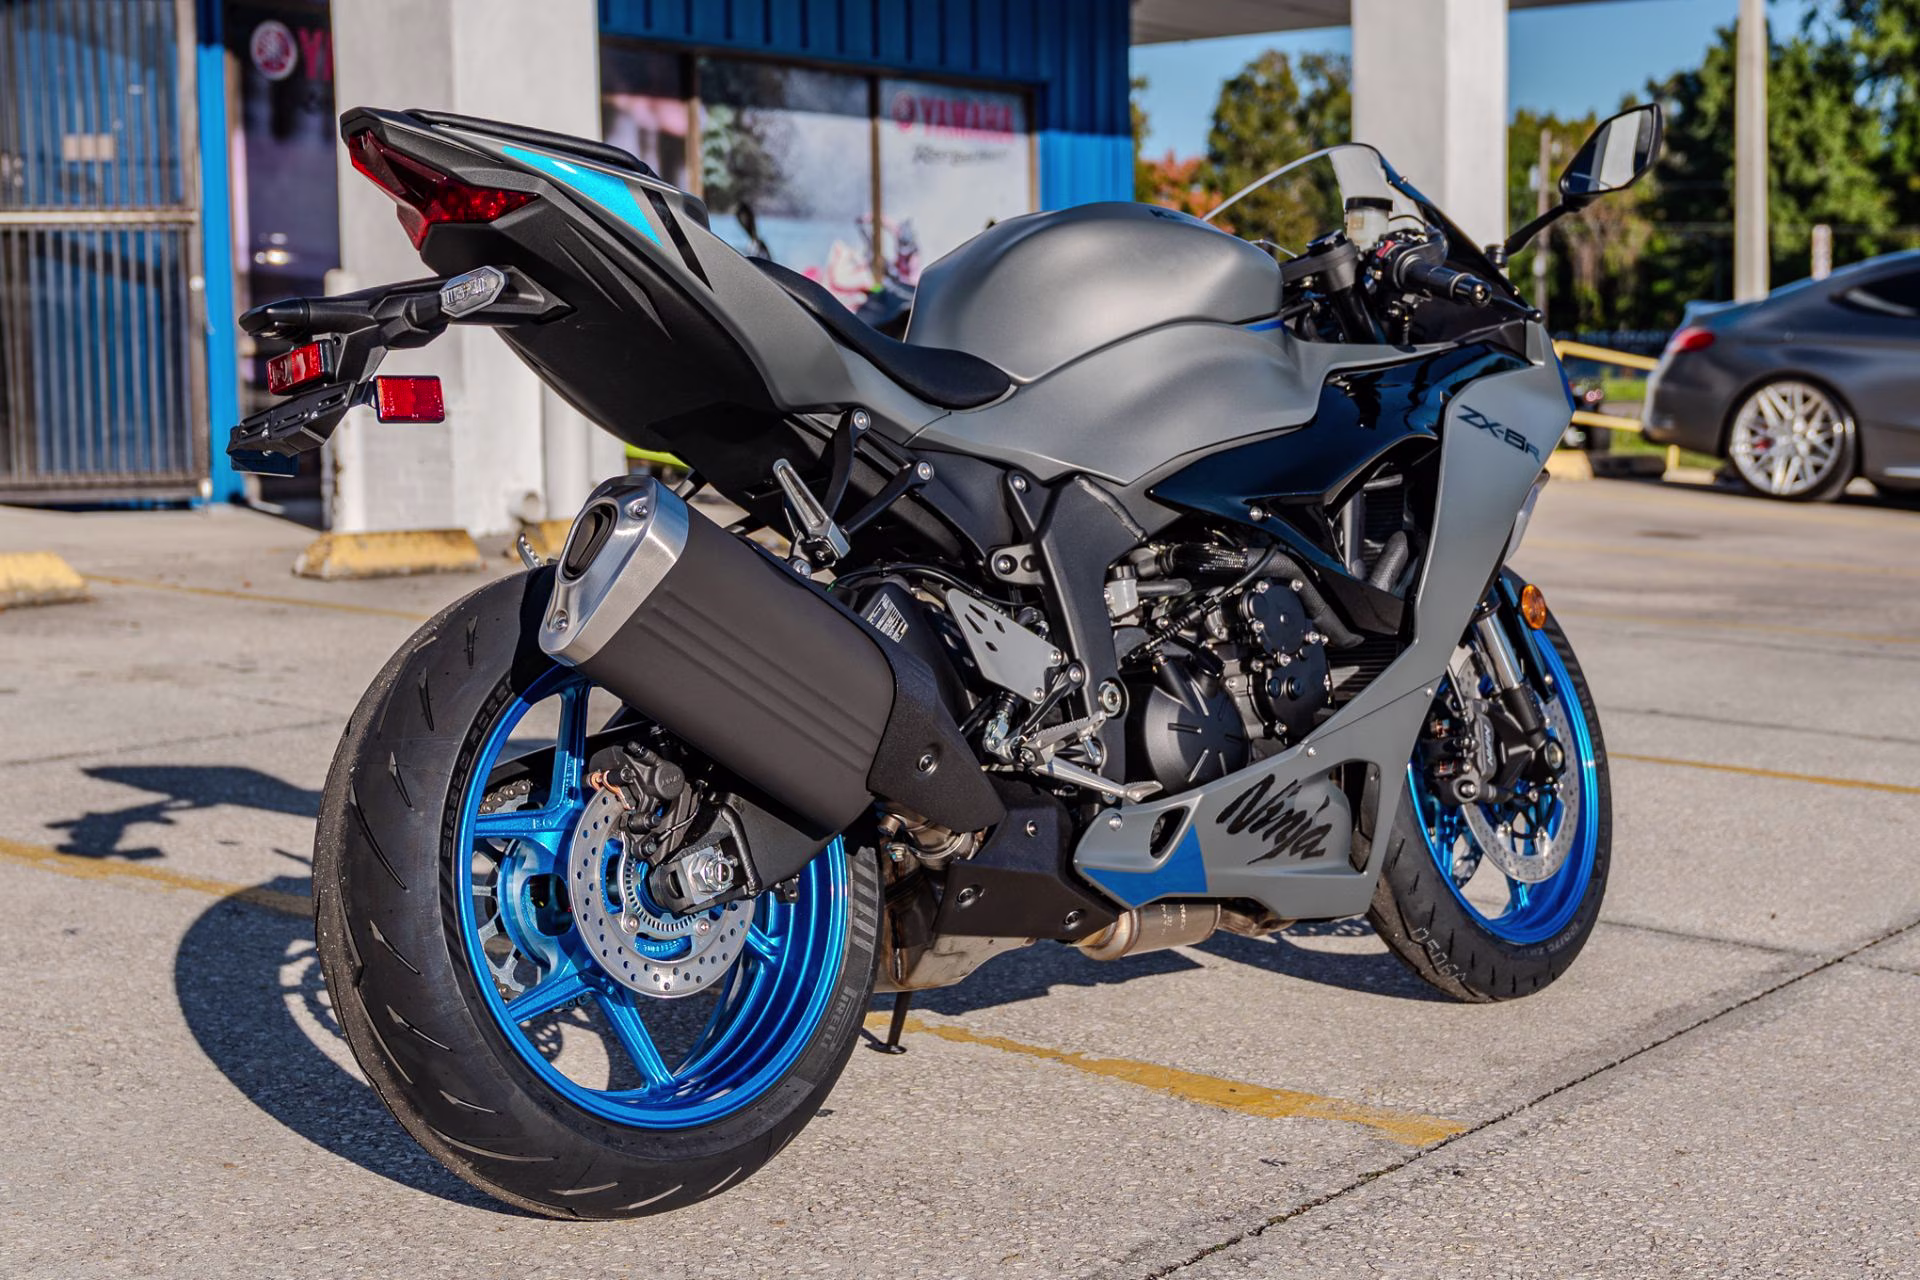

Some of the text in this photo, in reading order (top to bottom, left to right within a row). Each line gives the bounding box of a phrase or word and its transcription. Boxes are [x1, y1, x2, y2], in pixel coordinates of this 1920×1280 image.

[919, 95, 1014, 145] YAMAHA
[1456, 404, 1541, 464] ZX-6R
[1215, 773, 1333, 866] Ninja
[819, 985, 859, 1053] PIRELLI
